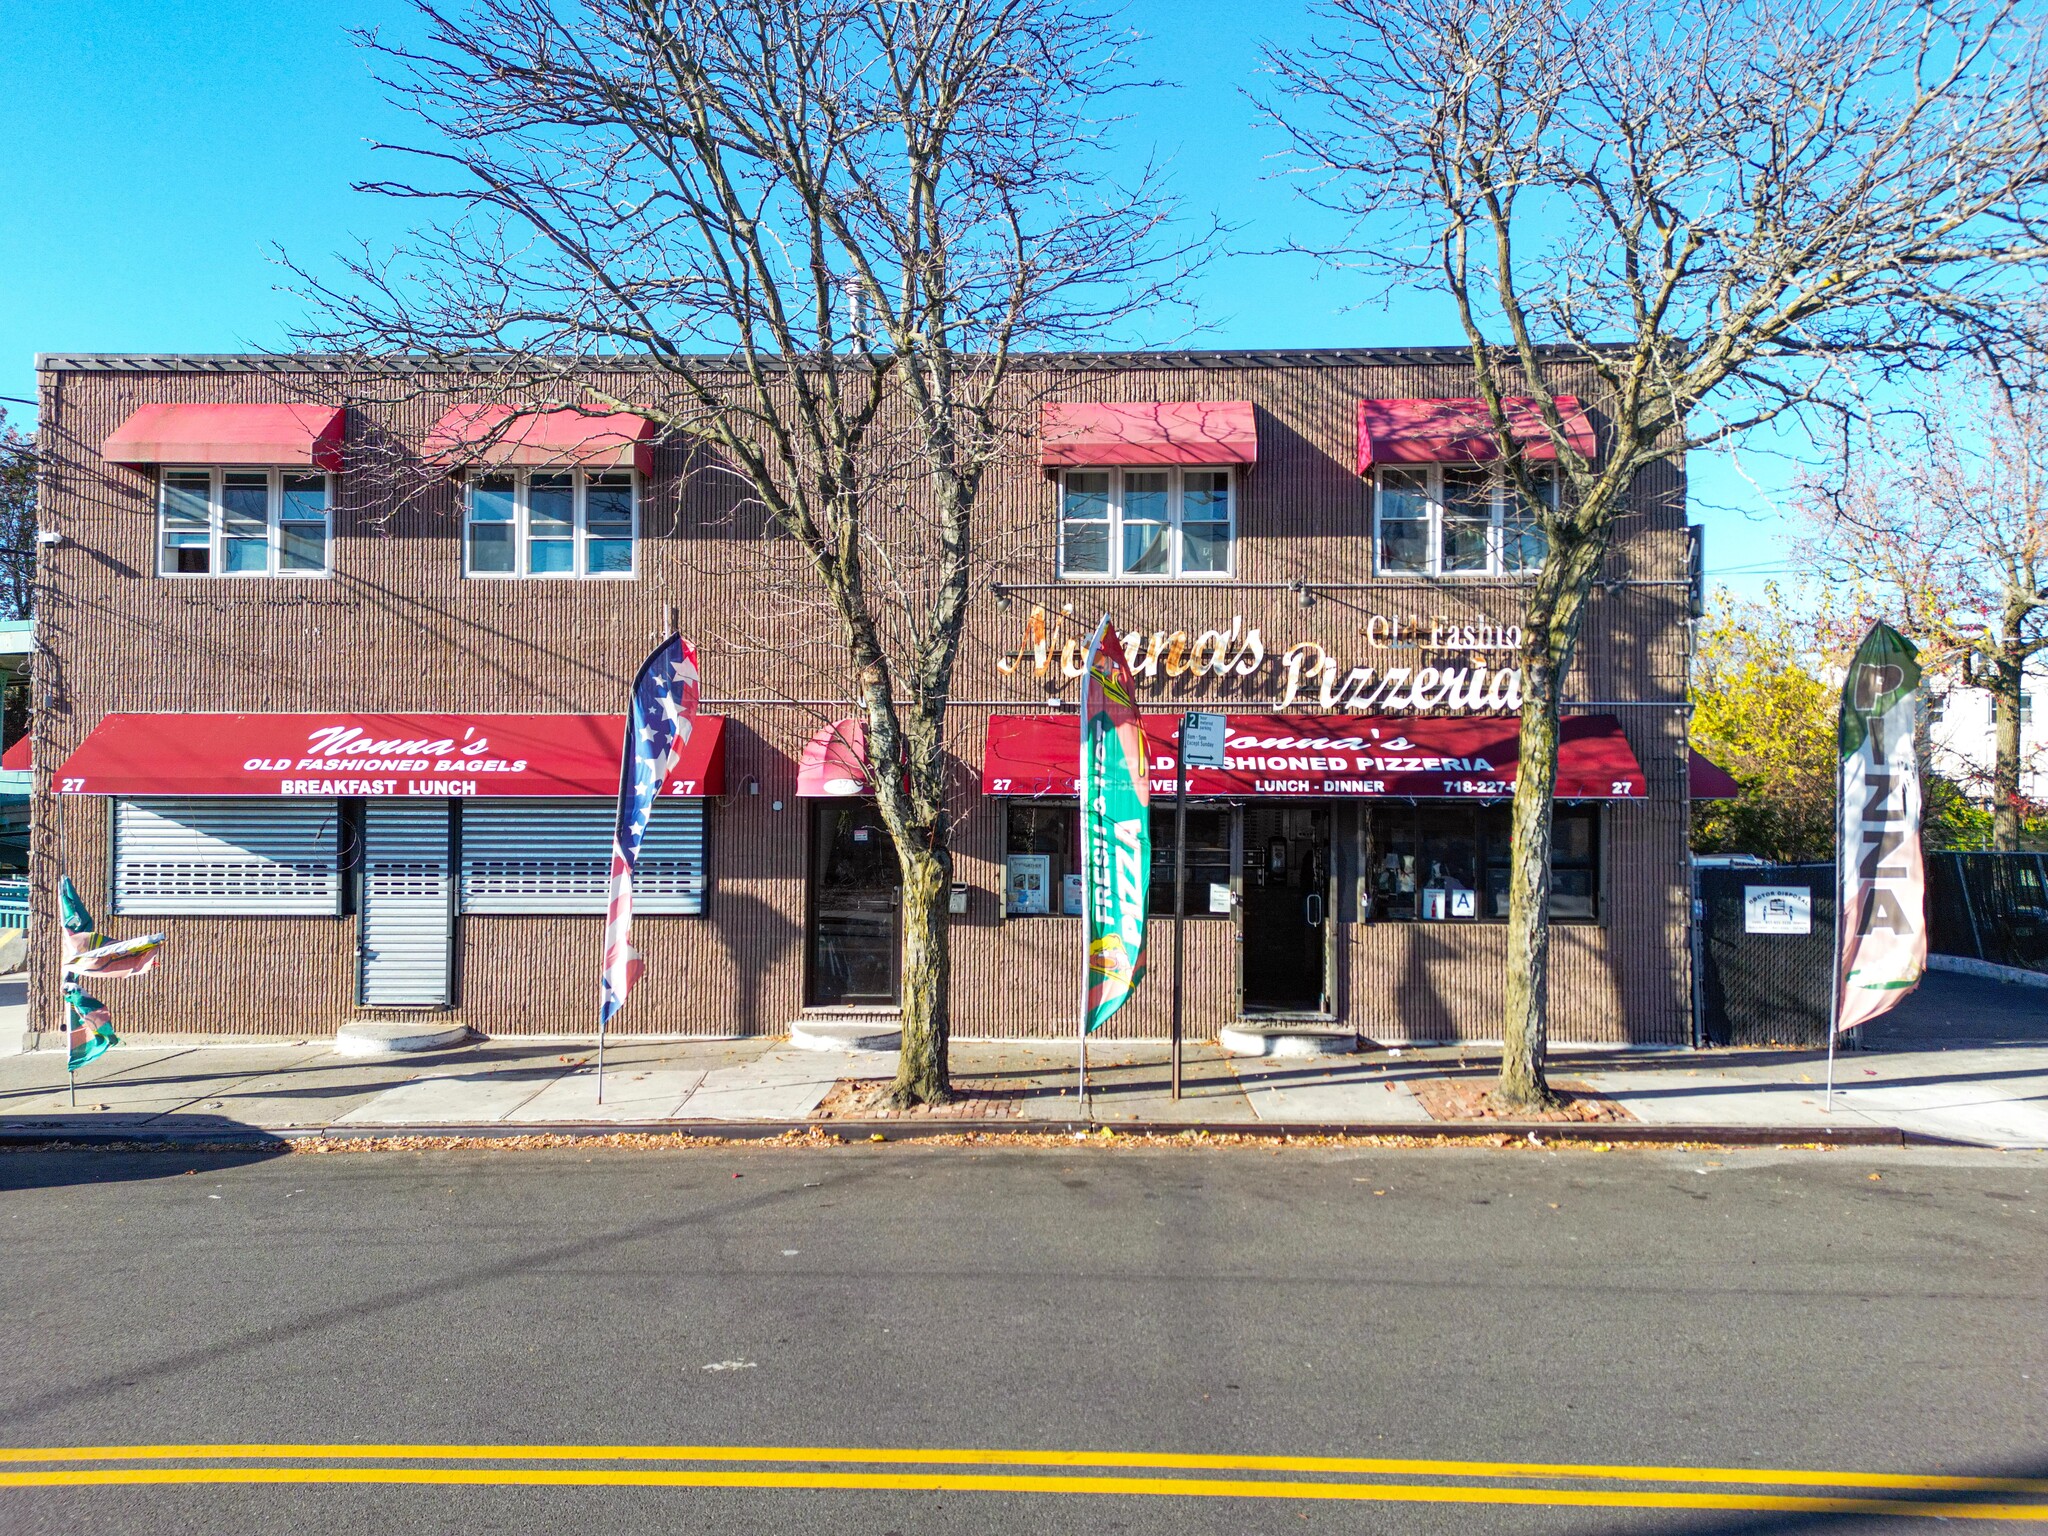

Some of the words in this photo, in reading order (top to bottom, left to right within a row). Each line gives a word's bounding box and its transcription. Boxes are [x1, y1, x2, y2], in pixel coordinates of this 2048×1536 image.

[1366, 614, 1418, 649] Old
[1430, 614, 1523, 649] Fashio
[1272, 641, 1523, 711] Pizzeria
[1189, 714, 1197, 728] 2
[307, 725, 489, 756] Nonna's
[1200, 740, 1214, 748] Sunday
[243, 758, 291, 771] OLD
[295, 758, 429, 772] FASHIONED
[434, 759, 527, 772] BAGELS
[1186, 757, 1347, 771] SHIONED
[1356, 757, 1495, 772] PIZZERIA
[62, 778, 85, 792] 27
[281, 779, 397, 795] BREAKFAST
[408, 780, 476, 795] LUNCH
[672, 781, 695, 794] 27
[992, 779, 1012, 791] 27
[1255, 780, 1310, 793] LUNCH
[1323, 780, 1385, 793] DINNER
[1444, 780, 1517, 794] 718-227-8
[1612, 782, 1632, 794] 27
[1853, 662, 1914, 938] PIZZA
[1114, 818, 1142, 949] PIZZA
[1457, 893, 1470, 908] A
[1749, 891, 1775, 905] DOCTOR
[1777, 890, 1809, 906] DISPOSAL
